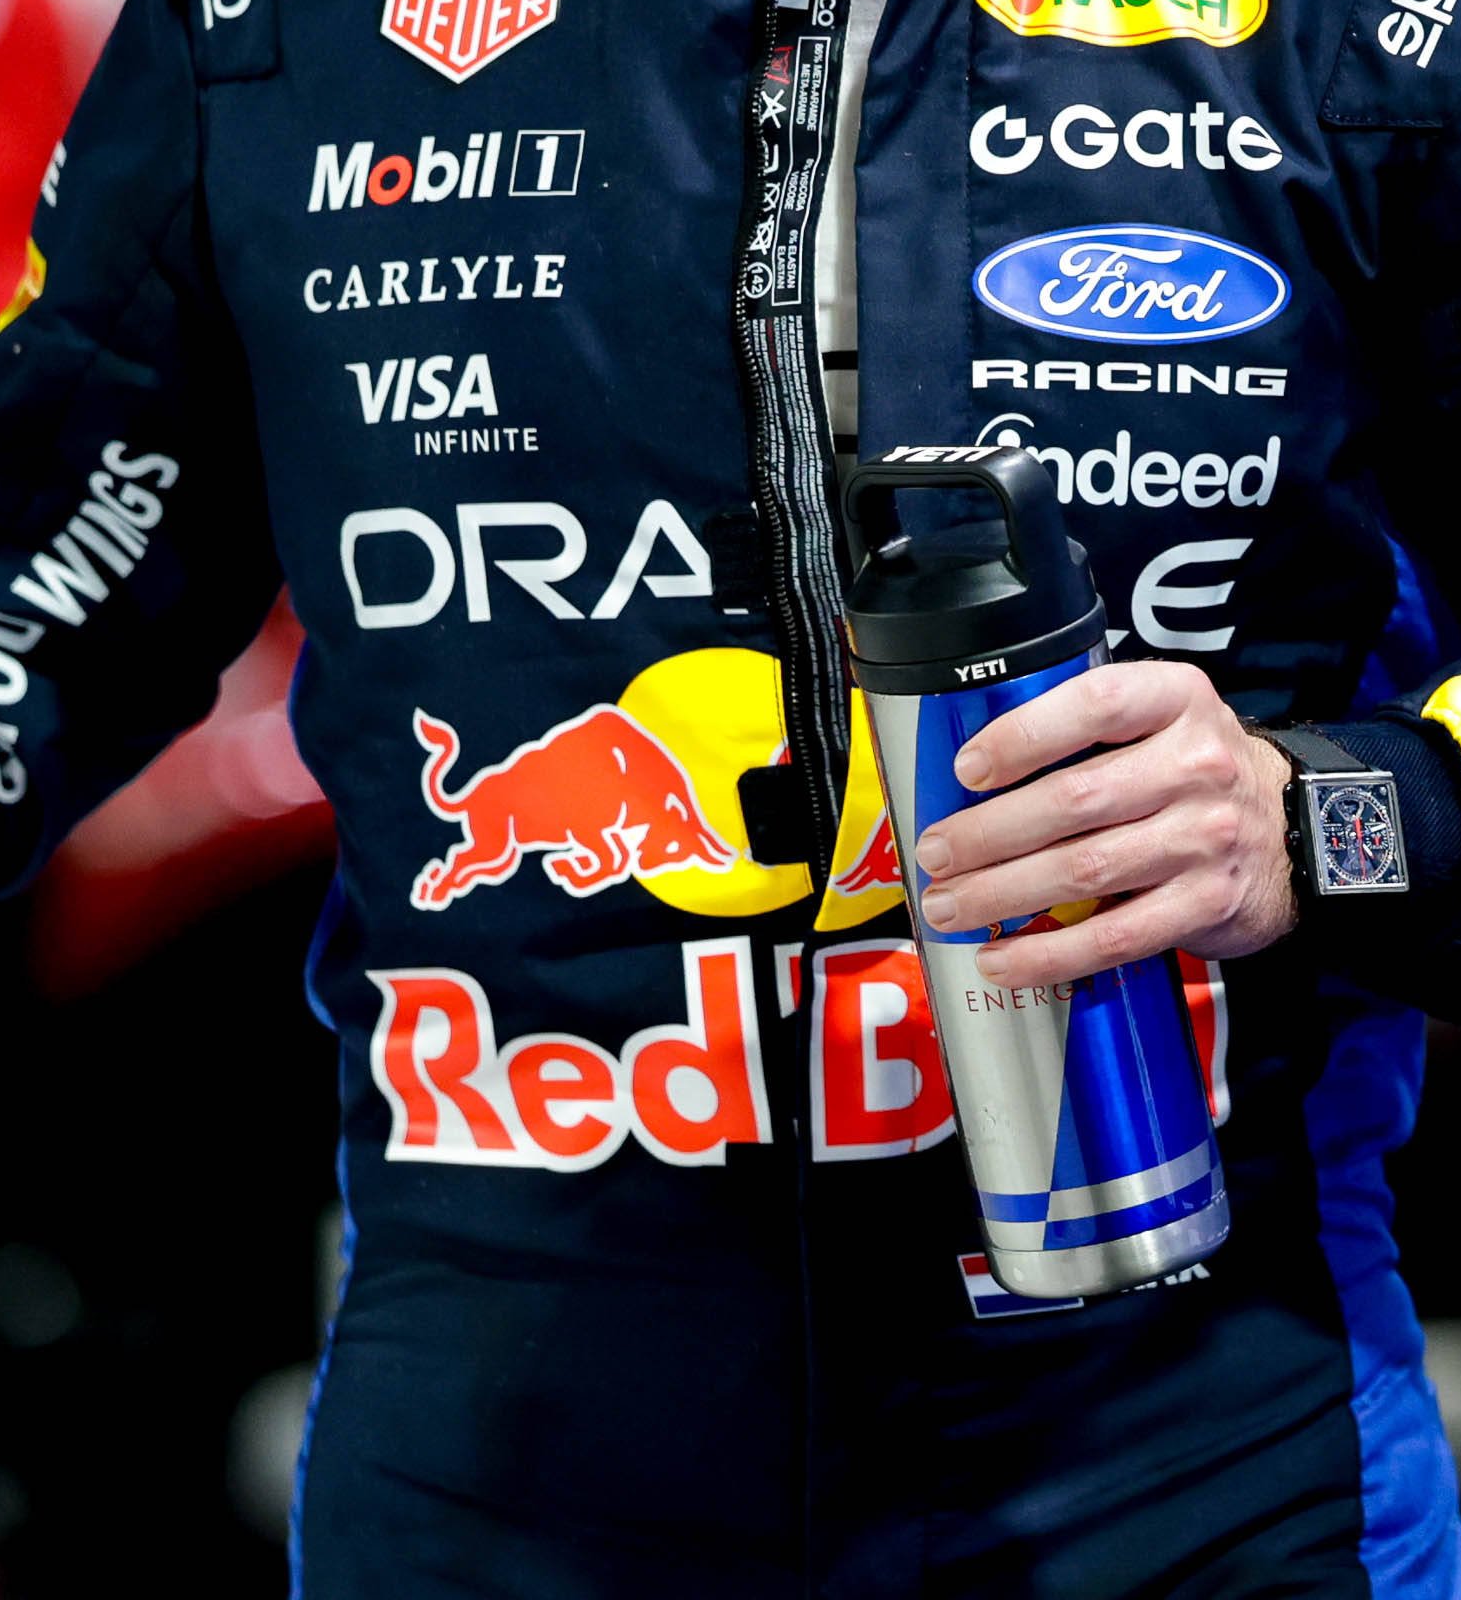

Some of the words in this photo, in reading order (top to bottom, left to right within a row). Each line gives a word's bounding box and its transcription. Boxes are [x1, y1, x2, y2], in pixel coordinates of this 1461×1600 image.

[307, 131, 502, 212] Mobil
[303, 254, 567, 313] CARLYLE
[751, 266, 764, 294] 142
[787, 245, 798, 289] ELASTAN
[1038, 243, 1227, 324] Ford
[346, 353, 500, 425] VISA
[971, 359, 1288, 397] RACING
[415, 427, 539, 456] INFINITE
[882, 446, 1002, 463] YETI
[954, 657, 1007, 684] YETI
[965, 979, 1096, 1013] ENERG
[366, 936, 774, 1174] Red
